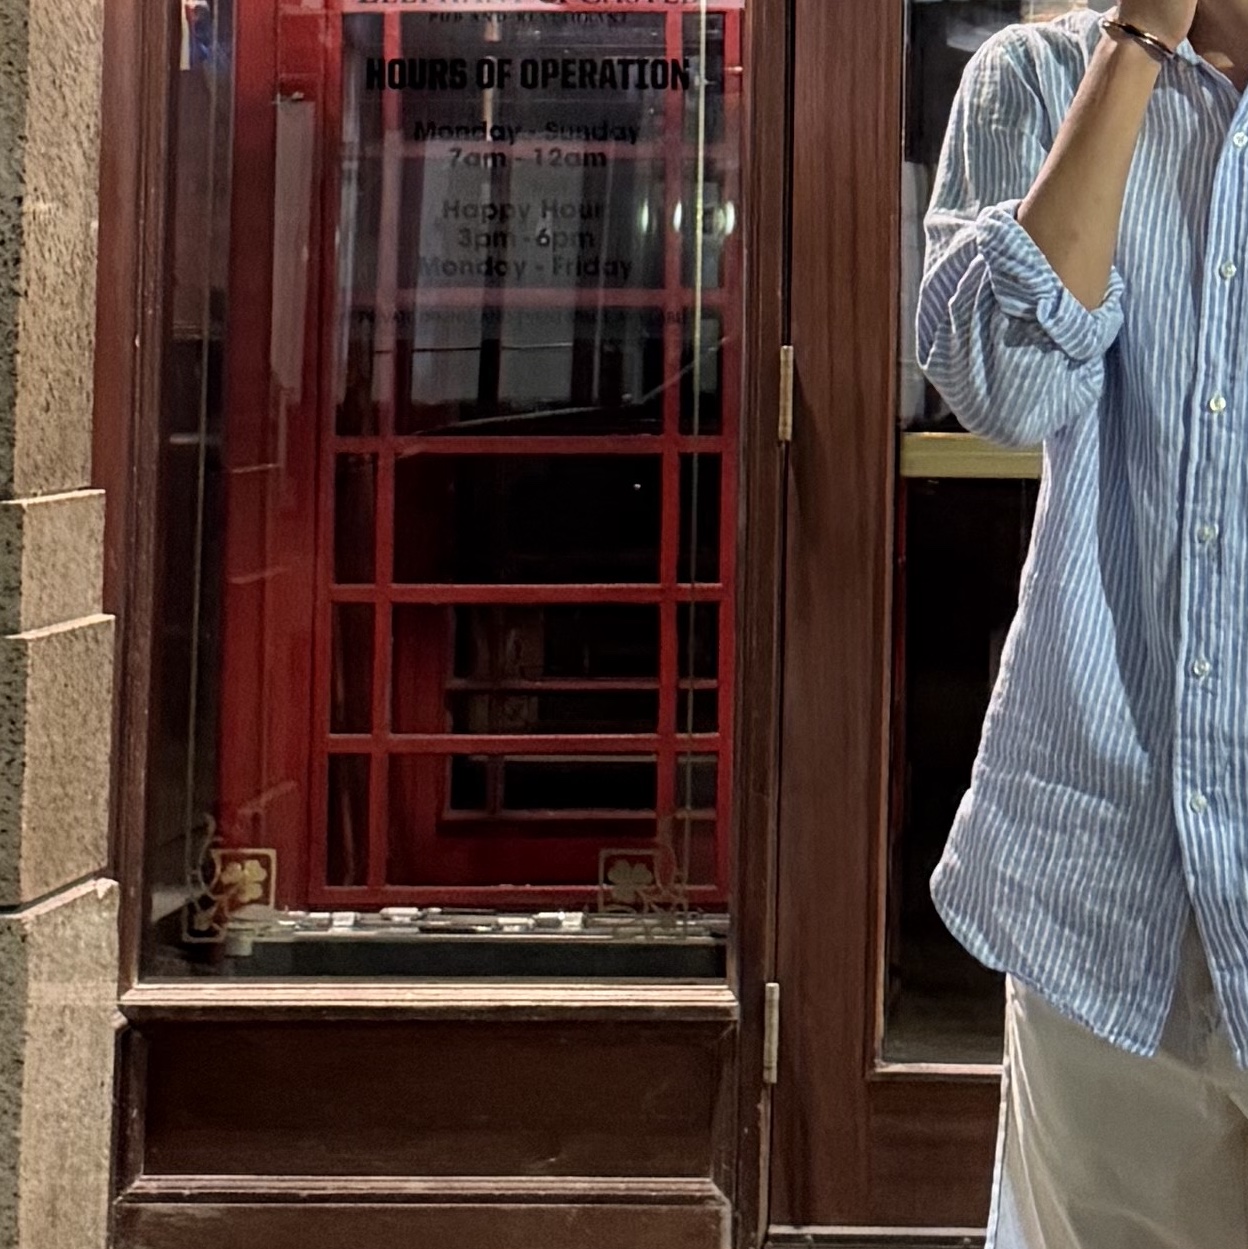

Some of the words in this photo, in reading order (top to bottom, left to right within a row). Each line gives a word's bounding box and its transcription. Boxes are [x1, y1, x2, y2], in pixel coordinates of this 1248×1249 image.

[365, 57, 468, 91] HOURS
[475, 57, 513, 90] OF
[520, 57, 690, 91] OPERATION
[413, 121, 522, 145] Monday
[545, 121, 641, 145] Sunday
[450, 148, 507, 168] 7am
[533, 147, 608, 168] 12am
[442, 200, 531, 224] Happy
[541, 200, 604, 219] Hour
[458, 228, 516, 251] 3pm
[536, 228, 596, 251] 6pm
[420, 256, 527, 281] Monday
[552, 256, 633, 281] Friday
